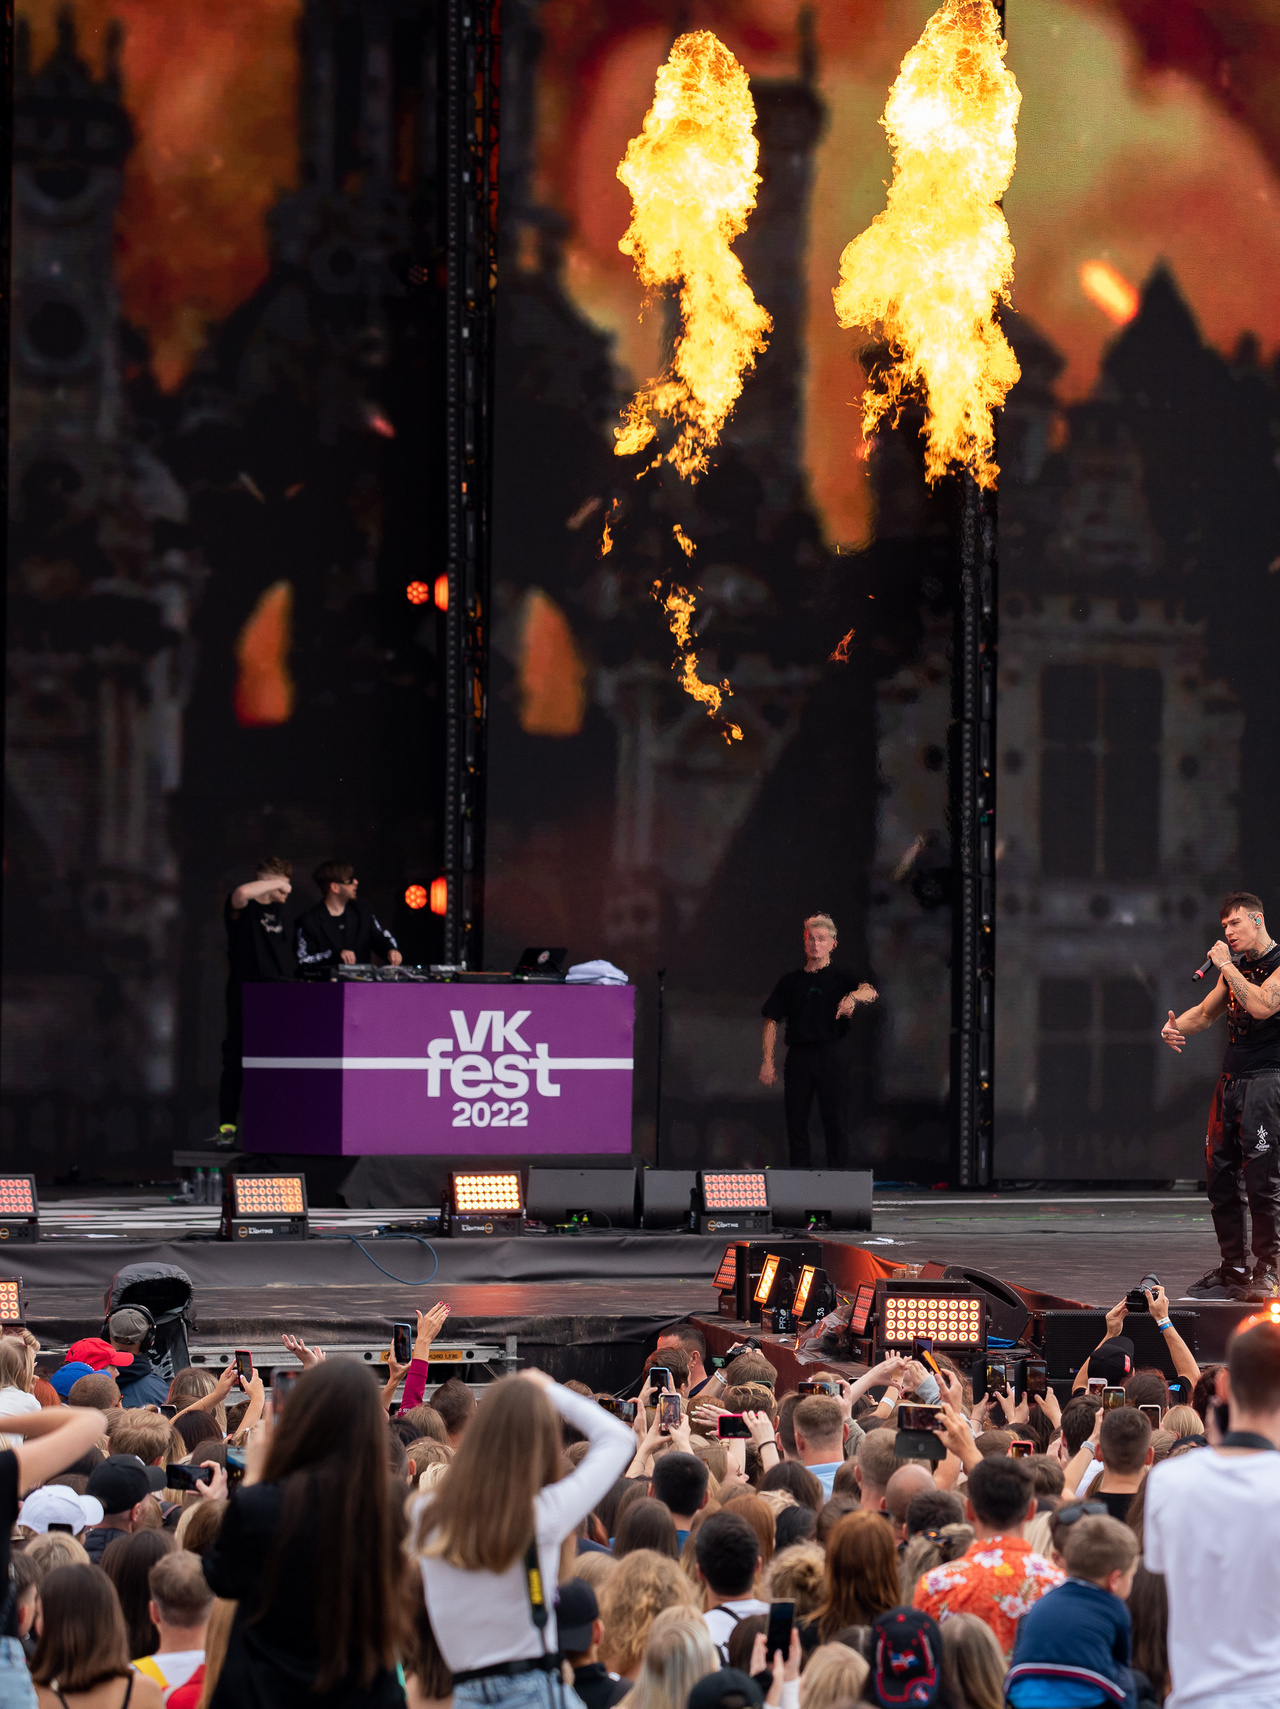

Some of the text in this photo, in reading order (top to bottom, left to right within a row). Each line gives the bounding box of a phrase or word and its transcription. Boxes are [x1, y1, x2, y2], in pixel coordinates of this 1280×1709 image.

[450, 1010, 532, 1052] VK
[427, 1038, 561, 1099] fest
[452, 1101, 530, 1128] 2022
